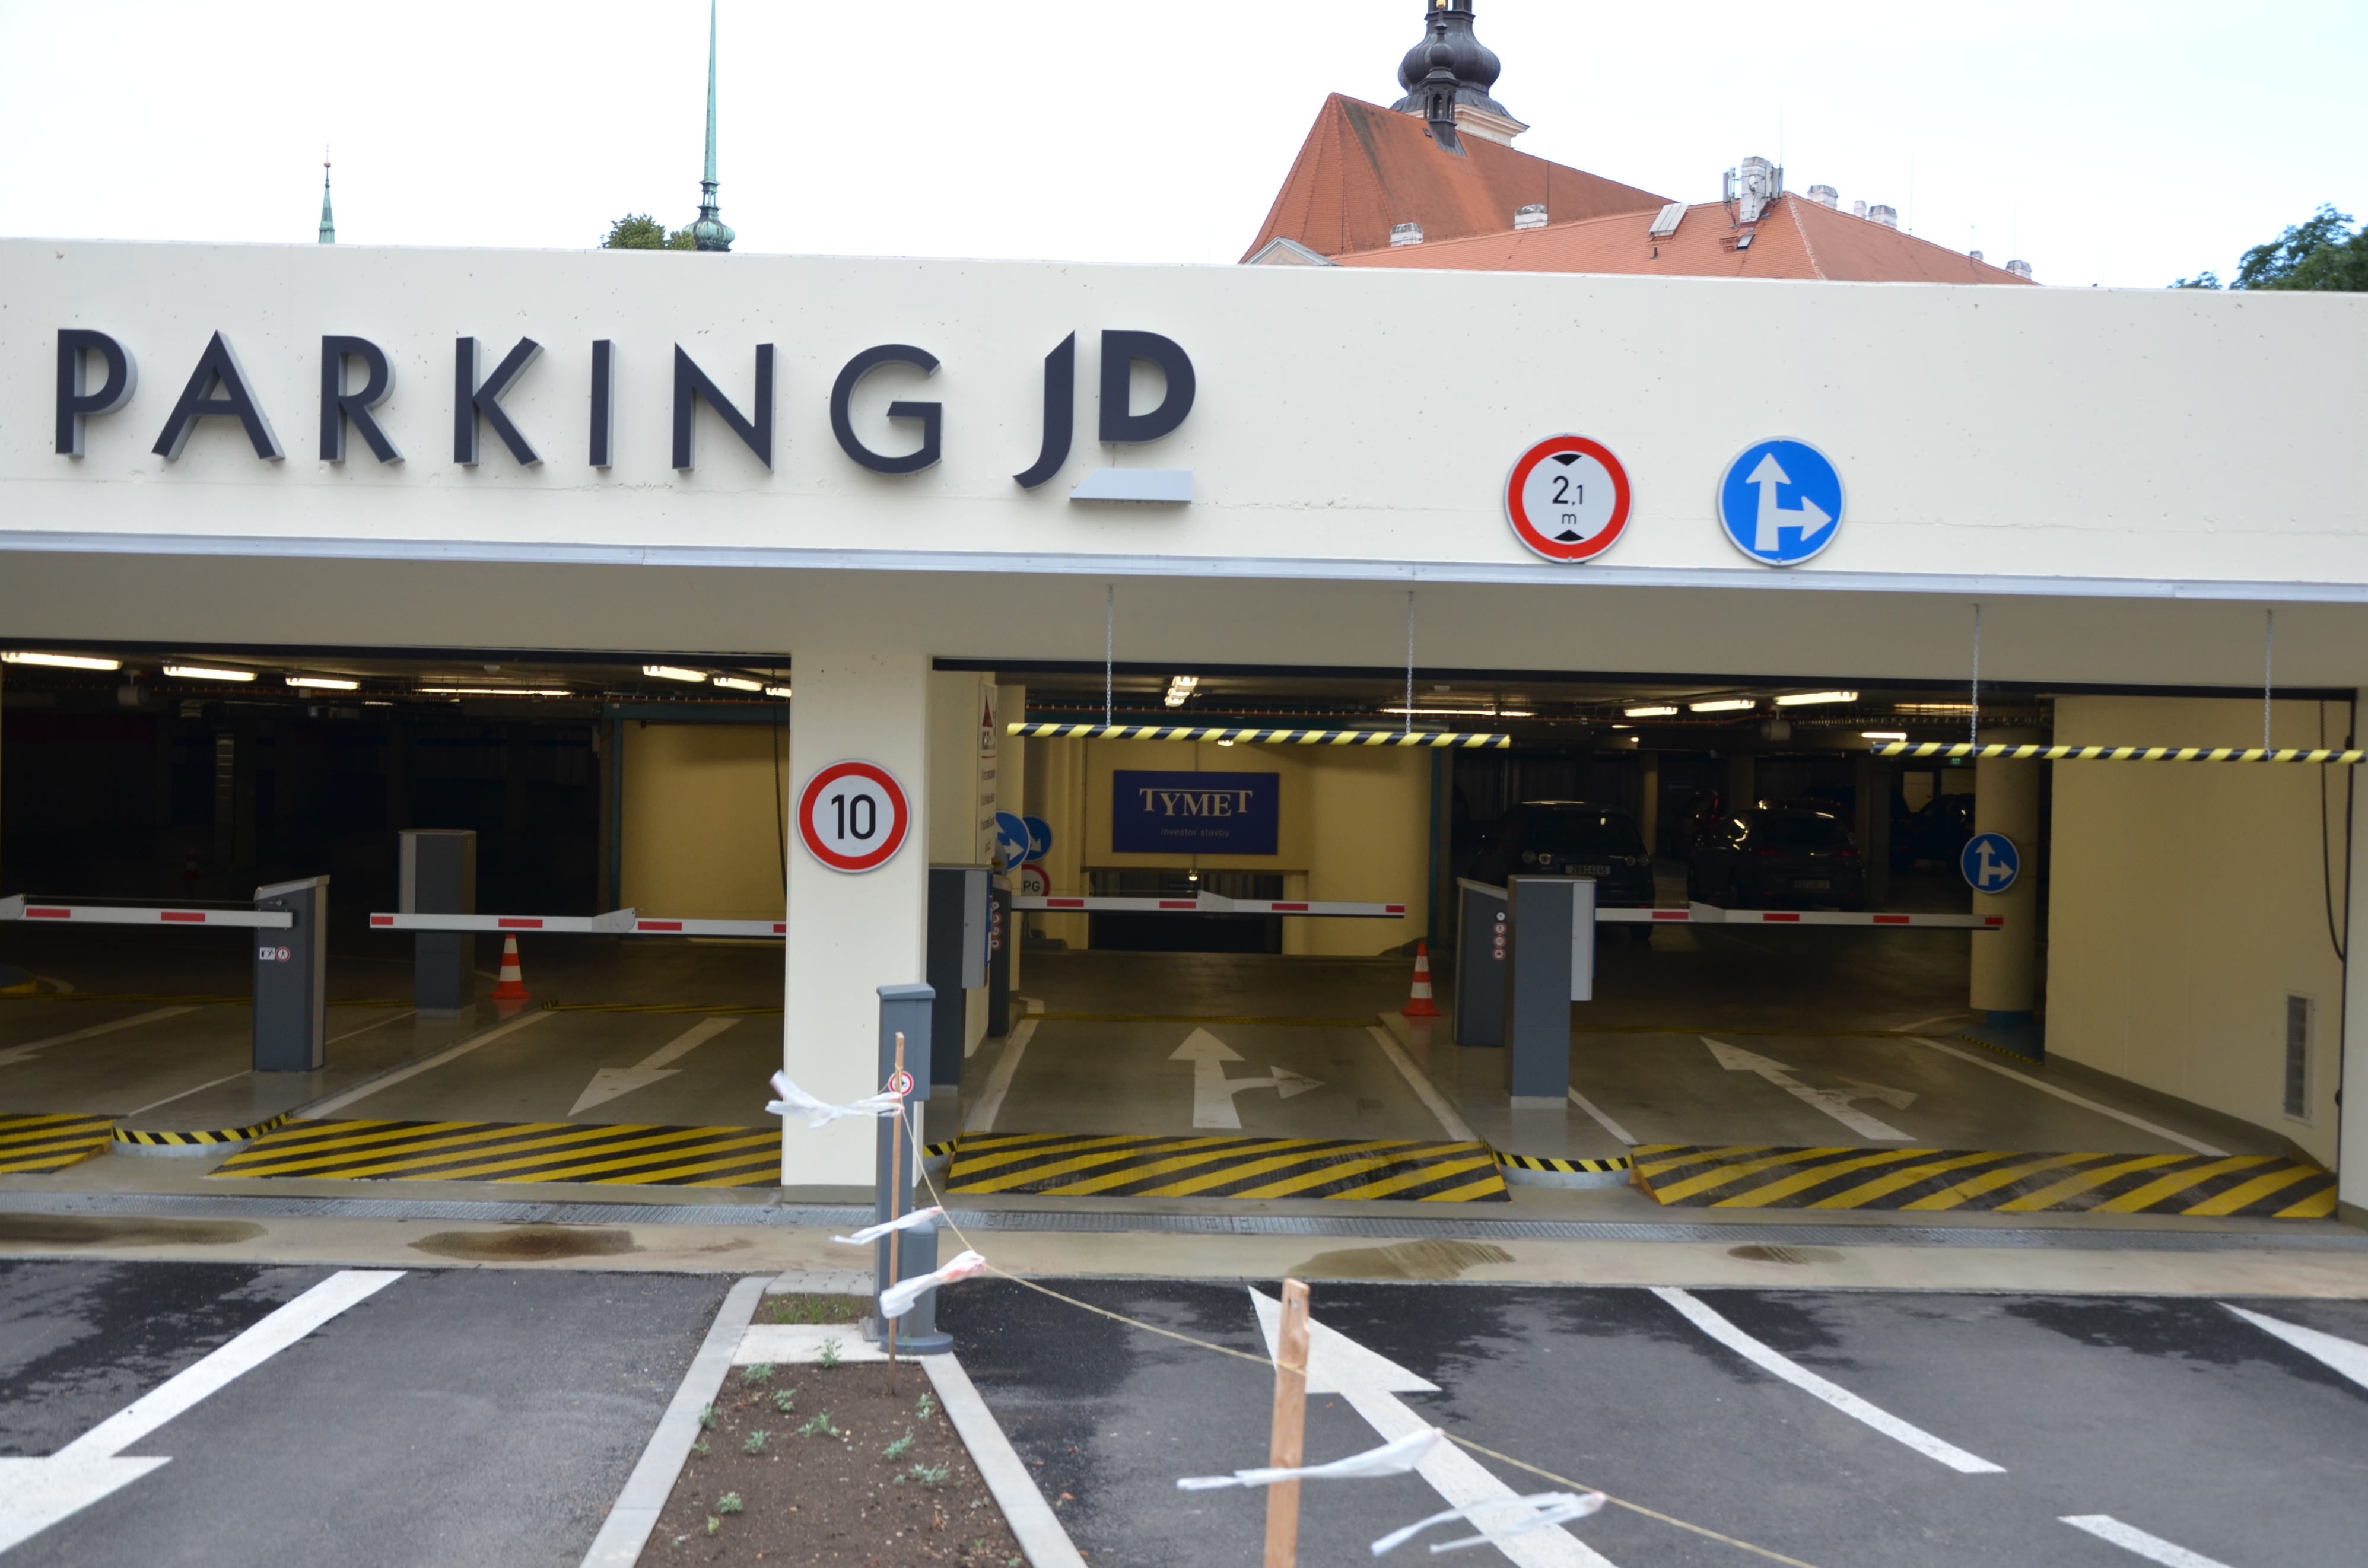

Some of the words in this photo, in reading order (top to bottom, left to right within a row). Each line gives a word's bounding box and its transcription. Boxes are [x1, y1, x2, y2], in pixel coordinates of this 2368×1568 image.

[55, 328, 944, 476] PARKING
[1012, 329, 1196, 489] JD
[1562, 513, 1576, 524] m
[1139, 788, 1253, 816] TYMET
[831, 794, 876, 840] 10
[1200, 829, 1229, 838] stavby
[1021, 880, 1040, 892] PG
